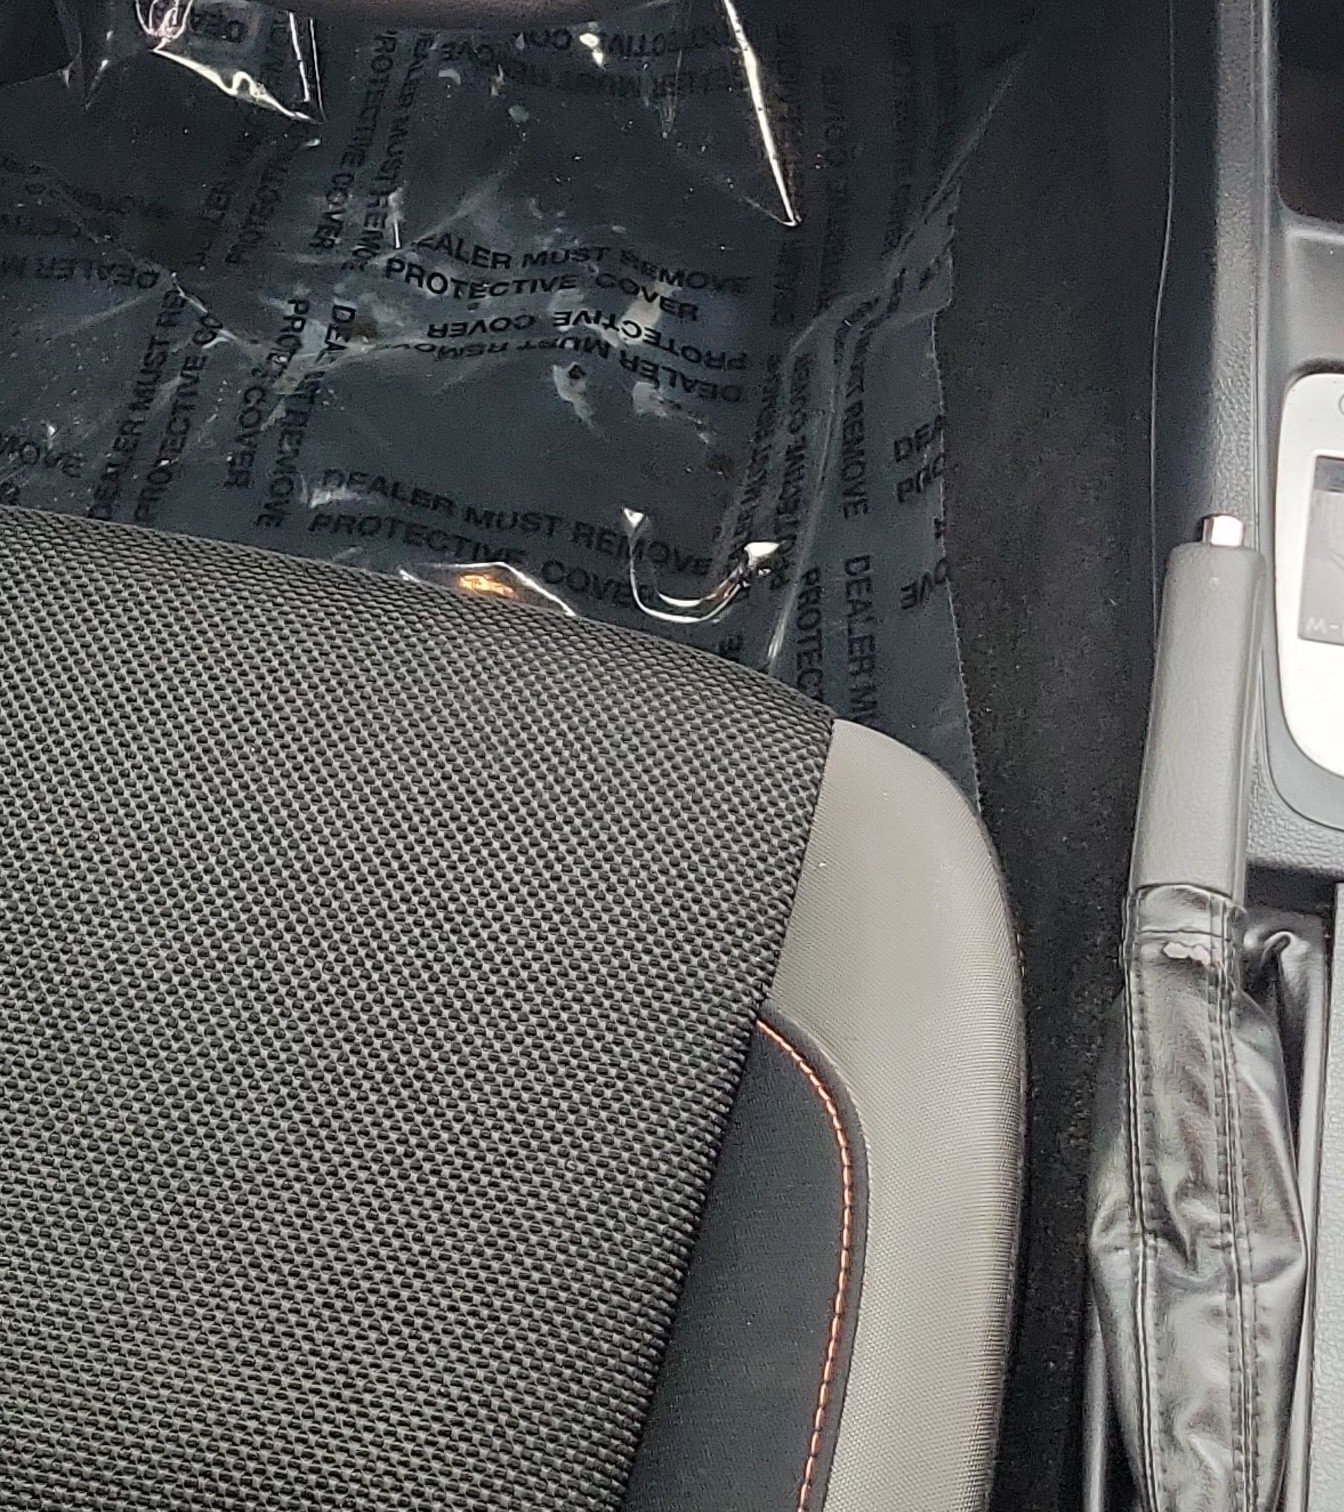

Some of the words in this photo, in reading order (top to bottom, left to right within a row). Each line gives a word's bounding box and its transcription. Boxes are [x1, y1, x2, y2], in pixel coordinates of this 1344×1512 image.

[339, 28, 399, 168] ROTECTIVE
[521, 243, 611, 269] MUST
[385, 257, 581, 301] PROTECTIVE
[593, 271, 700, 322] COVER
[426, 314, 537, 340] COVER
[552, 309, 749, 373] PROTECTIVE
[618, 349, 744, 405] DEALER
[320, 467, 457, 517] DEALER
[461, 503, 567, 540] MUST
[307, 509, 530, 566] PROTECTIVE
[795, 565, 825, 700] PROTEC
